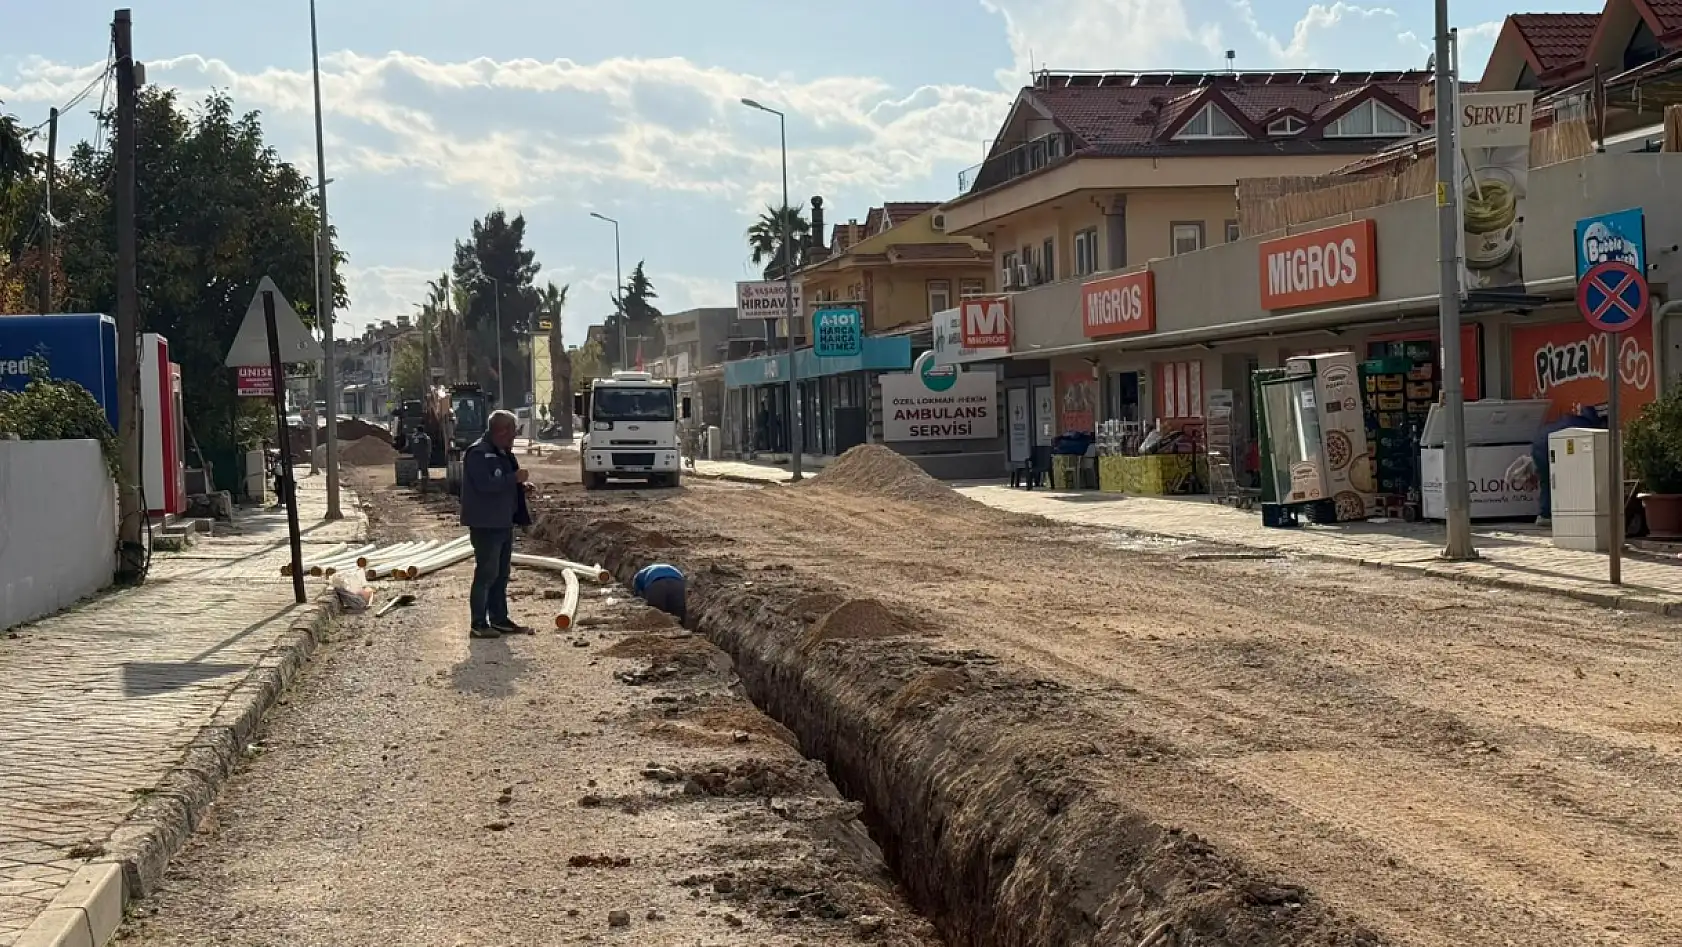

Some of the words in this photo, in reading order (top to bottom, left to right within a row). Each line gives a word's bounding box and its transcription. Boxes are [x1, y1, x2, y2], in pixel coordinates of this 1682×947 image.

[1462, 102, 1528, 128] SERVET
[741, 297, 800, 310] HIRDAVT
[966, 303, 1005, 335] M
[820, 326, 855, 334] HARCA
[820, 334, 855, 342] HARCA
[892, 396, 915, 406] ÖZEL
[917, 396, 955, 405] LOKMAN
[894, 406, 988, 421] AMBULANS
[909, 421, 973, 437] SERVİSİ
